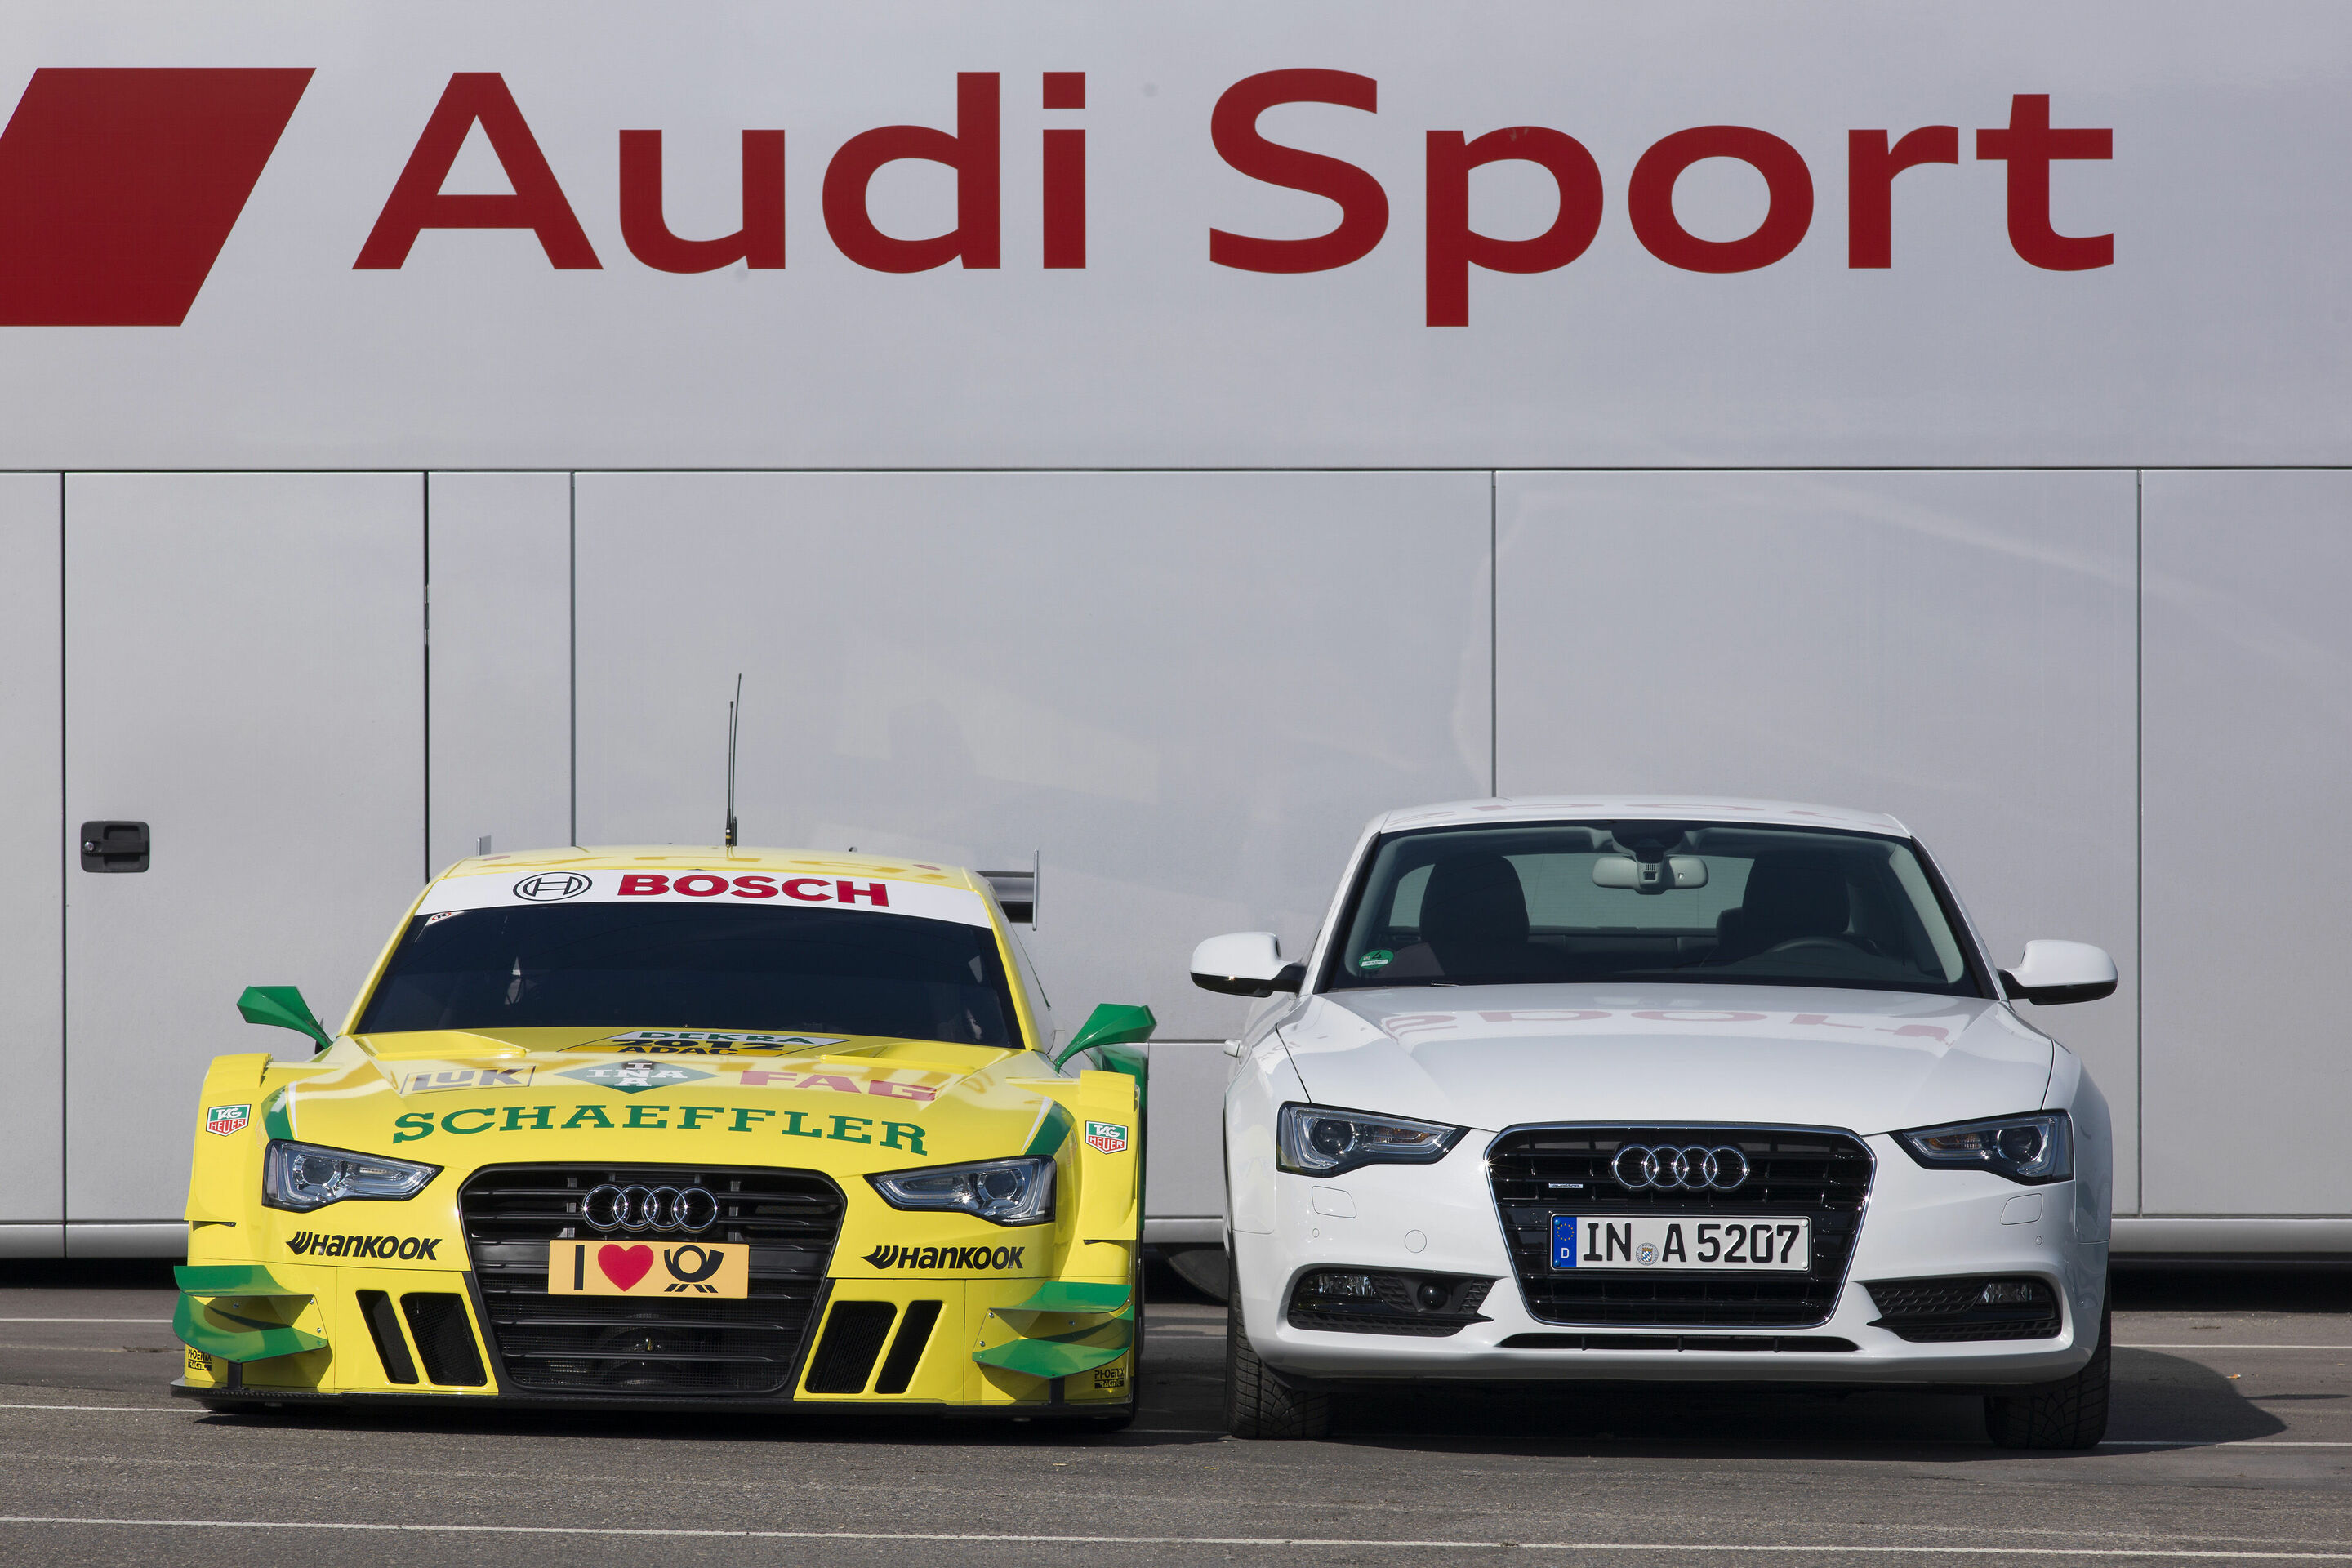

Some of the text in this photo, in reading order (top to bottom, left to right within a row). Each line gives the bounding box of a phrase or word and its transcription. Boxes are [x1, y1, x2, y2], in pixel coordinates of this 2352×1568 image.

[353, 67, 2114, 327] Audi Sport
[618, 874, 889, 907] BOSCH
[612, 1039, 785, 1051] 2012
[639, 1031, 815, 1045] DEKRA
[617, 1046, 739, 1055] ADAC
[740, 1070, 937, 1102] FAG
[216, 1107, 242, 1120] TAG
[210, 1119, 244, 1133] HEUER
[392, 1104, 929, 1156] SCHAEFFLER
[1093, 1125, 1120, 1138] TAG
[1089, 1136, 1124, 1151] HEUER
[1583, 1223, 1632, 1262] IN
[1661, 1223, 1686, 1263] A
[1697, 1223, 1800, 1263] 5207
[1561, 1247, 1570, 1258] D
[574, 1245, 585, 1290] I
